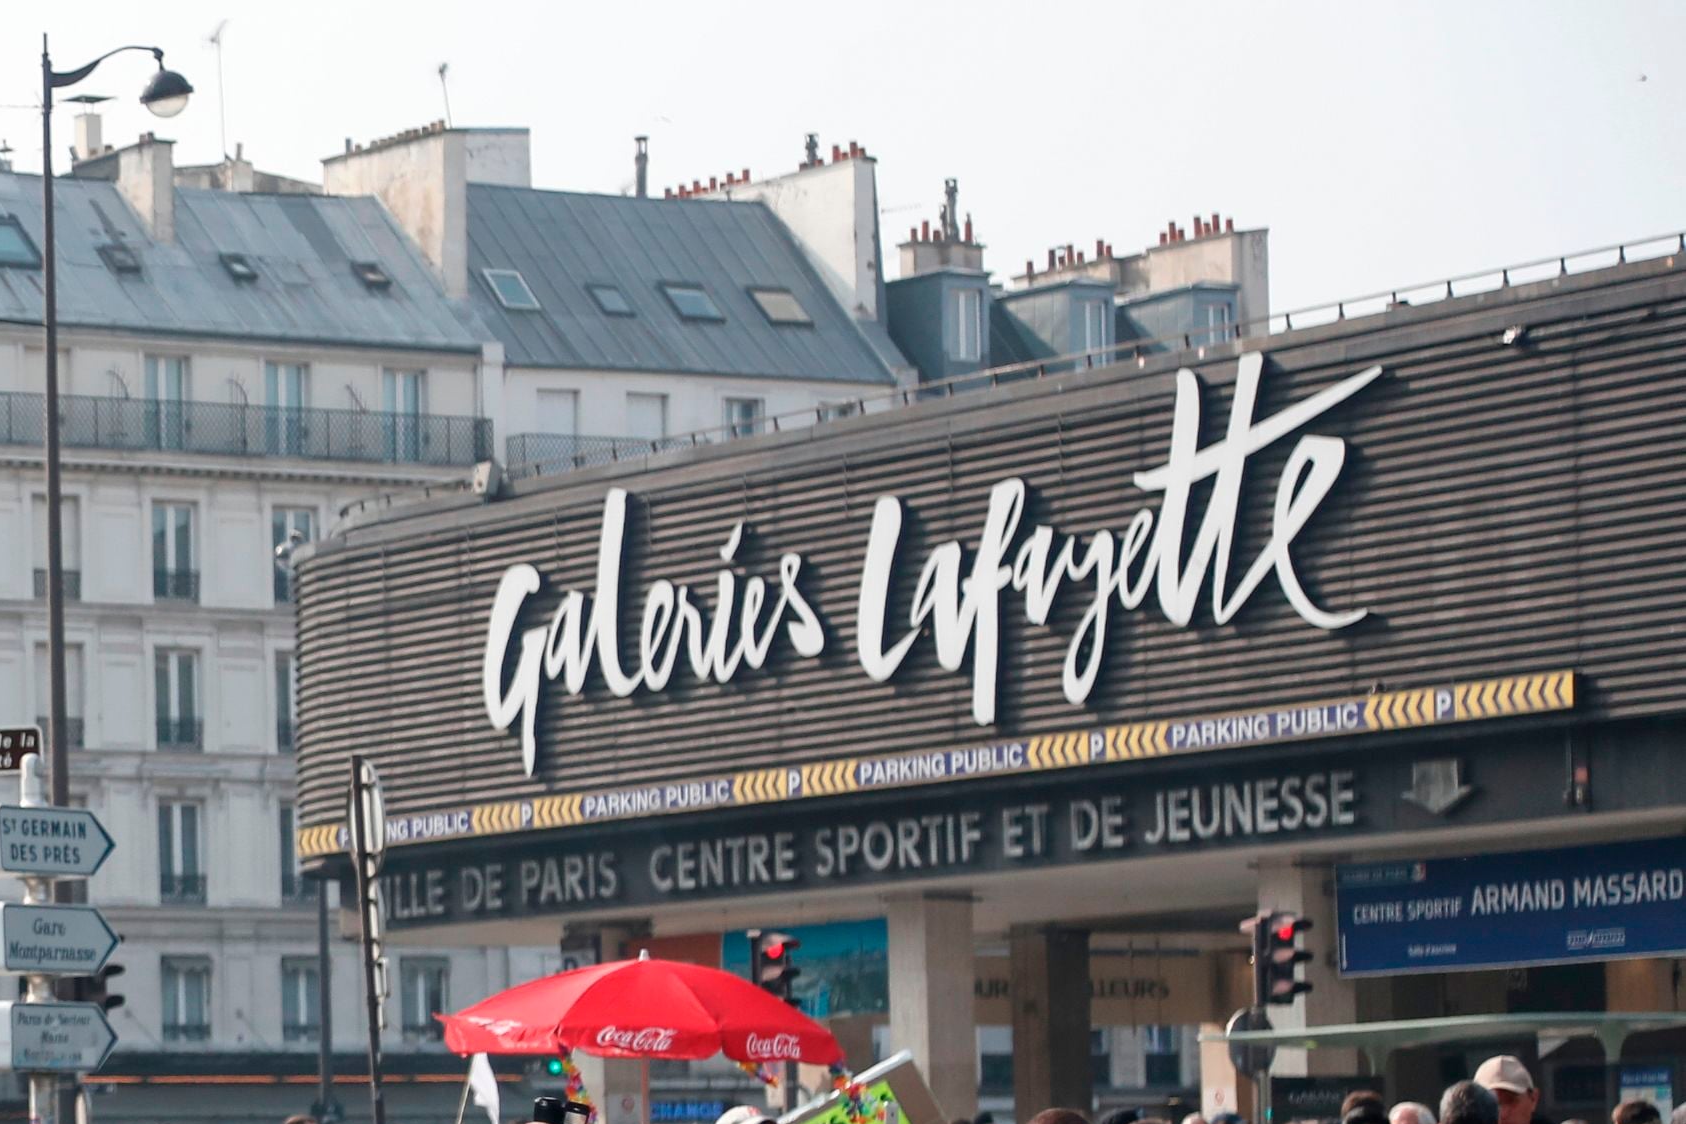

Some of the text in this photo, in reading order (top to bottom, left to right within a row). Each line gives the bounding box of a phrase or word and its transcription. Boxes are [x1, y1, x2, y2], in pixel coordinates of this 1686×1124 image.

[482, 350, 1384, 778] Galeries Lafayette
[20, 732, 35, 748] la
[413, 812, 469, 839] PUBLIC
[584, 789, 660, 819] PARKING
[665, 780, 730, 808] PUBLIC
[788, 772, 801, 794] P
[860, 752, 946, 785] PARKING
[951, 742, 1024, 774] PUBLIC
[1090, 736, 1104, 758] P
[1171, 714, 1270, 750] PARKING
[1277, 702, 1360, 737] PUBLIC
[1435, 691, 1451, 719] P
[21, 820, 87, 839] GERMAIN
[461, 864, 504, 911] DE
[521, 851, 618, 904] PARIS
[649, 832, 796, 893] CENTRE
[814, 811, 983, 878] SPORTIF
[1001, 804, 1049, 858] ET
[1070, 796, 1125, 851] DE
[1144, 770, 1356, 845] JEUNESSE
[11, 843, 38, 862] DES
[1353, 867, 1685, 926] CENTRE SPORTIF ARMAND MASSARD
[32, 916, 66, 938] Gare
[9, 941, 97, 964] Montparnasse
